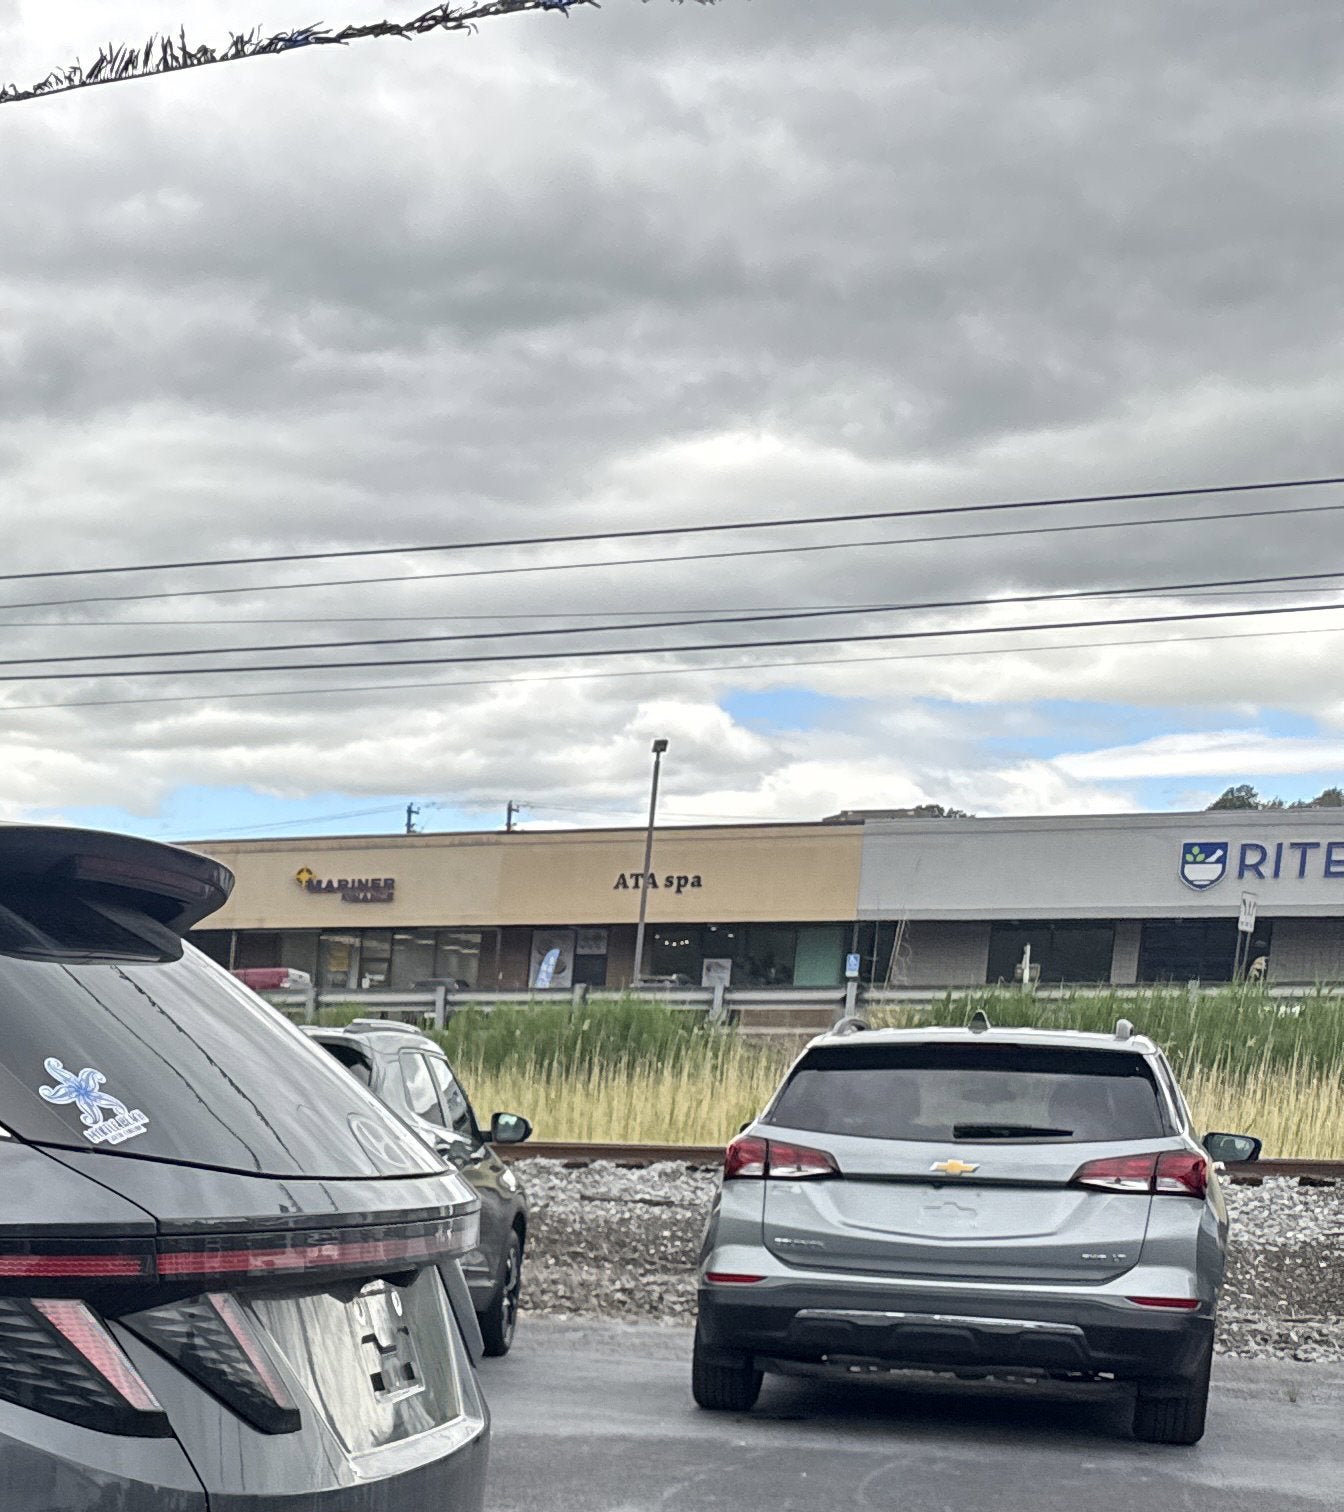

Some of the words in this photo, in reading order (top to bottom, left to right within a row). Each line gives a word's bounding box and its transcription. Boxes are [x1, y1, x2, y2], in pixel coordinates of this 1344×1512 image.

[1237, 841, 1344, 880] RITE
[307, 877, 395, 893] MARINER
[613, 873, 660, 890] ATA
[664, 875, 703, 894] spa
